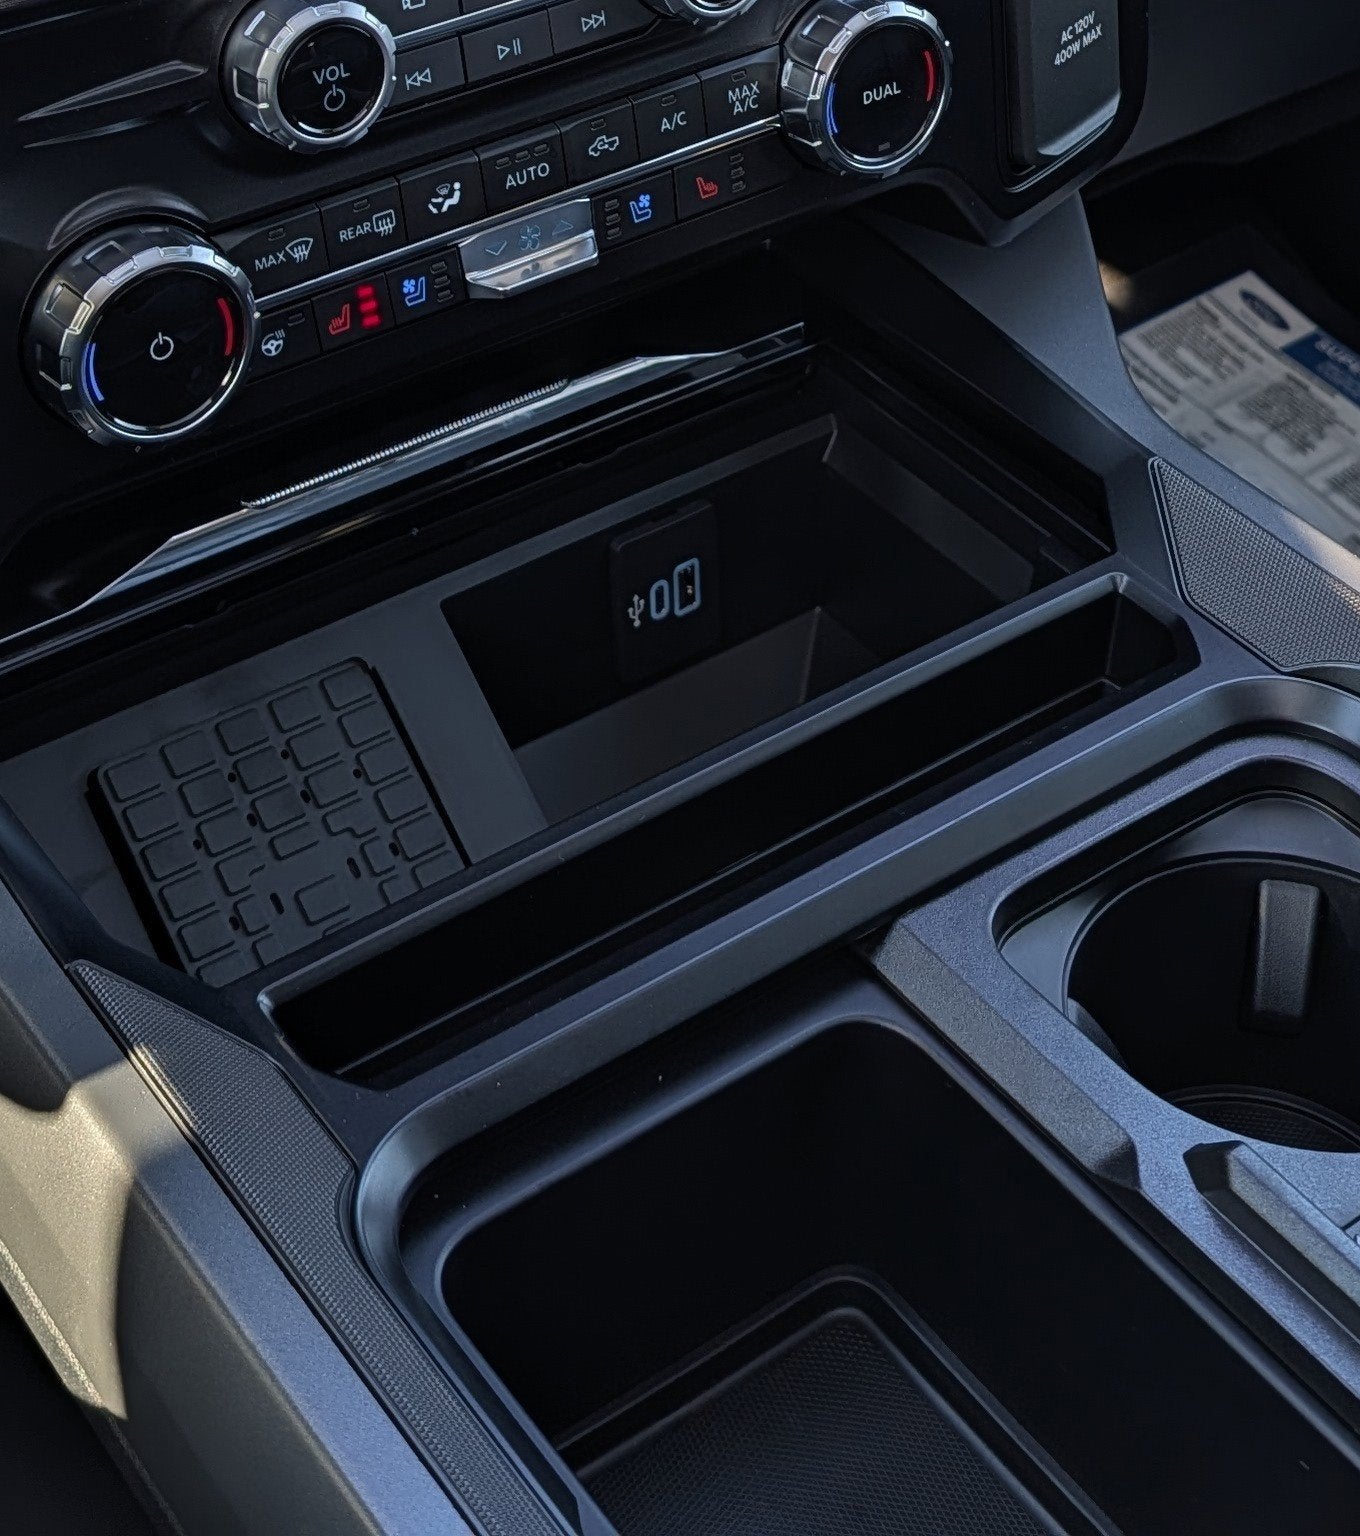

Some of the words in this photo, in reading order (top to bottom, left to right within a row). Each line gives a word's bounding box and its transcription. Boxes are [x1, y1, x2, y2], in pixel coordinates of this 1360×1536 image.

[1060, 26, 1074, 45] AC
[1075, 11, 1096, 32] 120V
[1054, 42, 1081, 66] 400W
[1083, 24, 1103, 48] MAX
[313, 64, 351, 86] VOL
[728, 81, 760, 103] MAX
[863, 81, 902, 105] DUAL
[733, 96, 759, 116] A/C
[660, 111, 687, 132] A/C
[505, 162, 550, 190] AUTO
[339, 222, 371, 242] REAR
[254, 250, 286, 272] MAX
